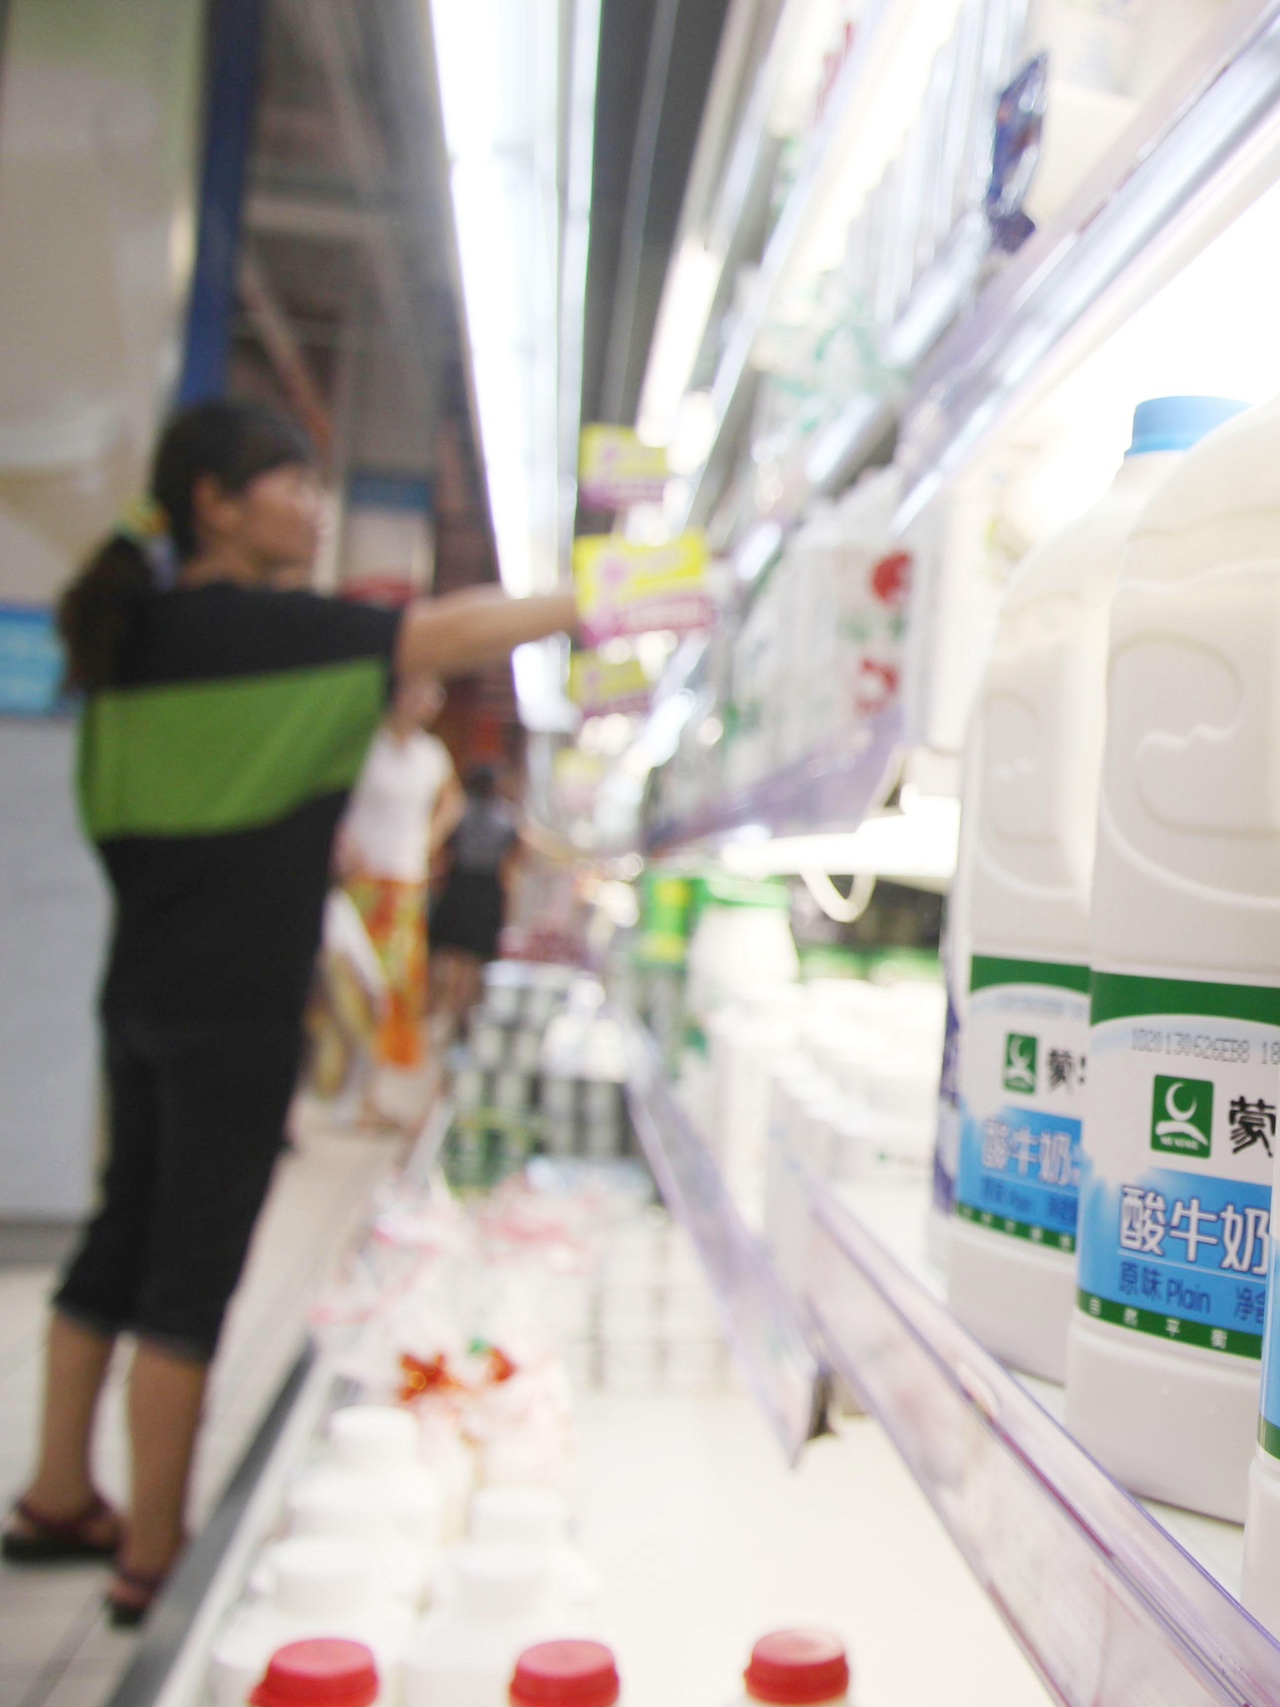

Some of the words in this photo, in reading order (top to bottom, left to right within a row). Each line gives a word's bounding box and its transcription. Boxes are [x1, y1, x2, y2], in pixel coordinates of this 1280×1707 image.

[1119, 1184, 1268, 1276] 酸牛奶
[1165, 1277, 1212, 1314] Plain
